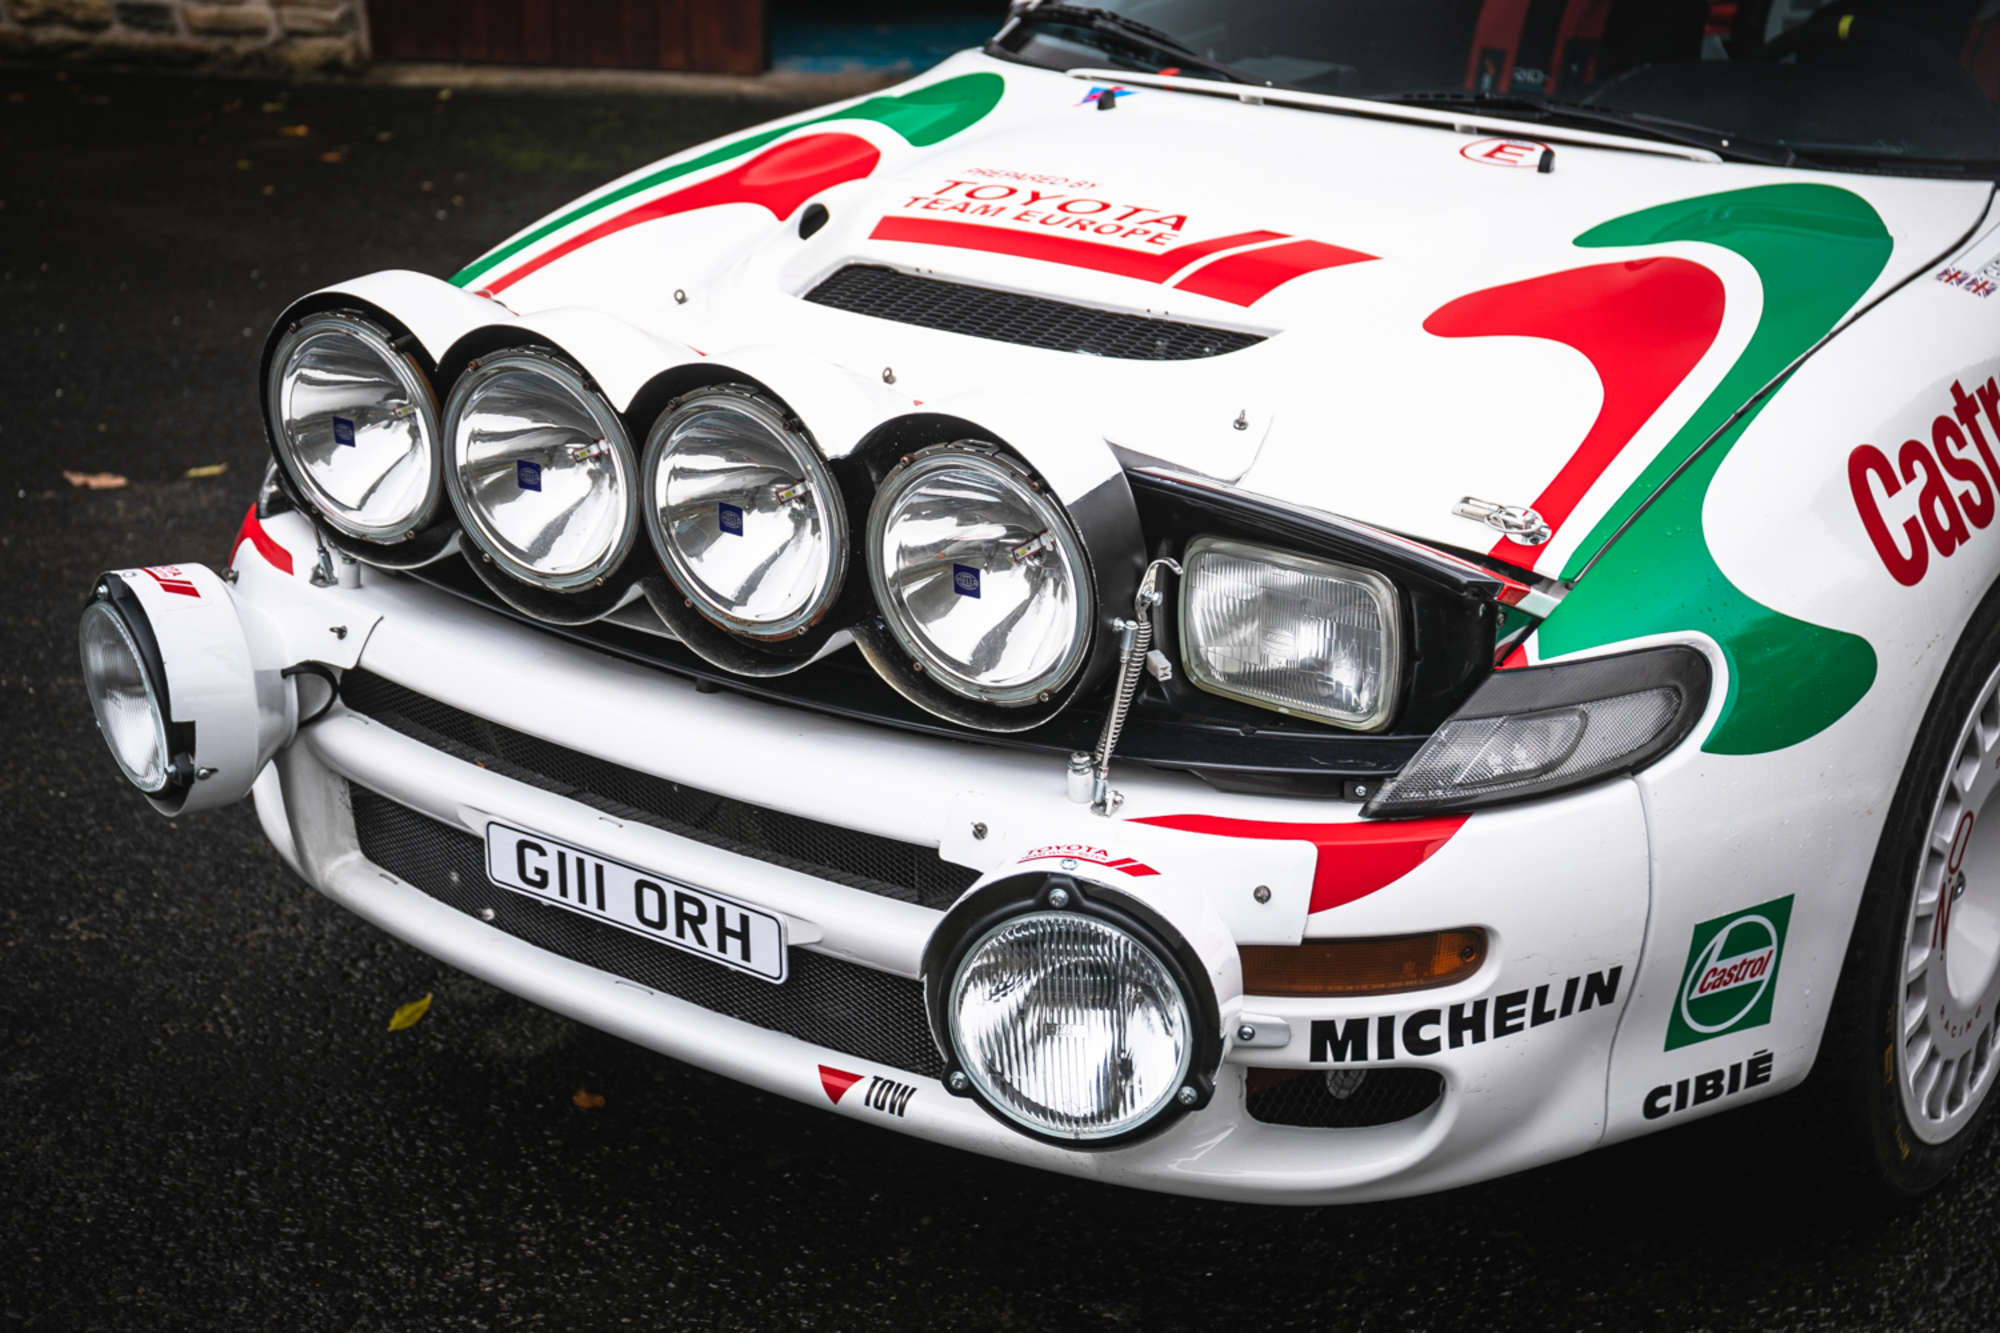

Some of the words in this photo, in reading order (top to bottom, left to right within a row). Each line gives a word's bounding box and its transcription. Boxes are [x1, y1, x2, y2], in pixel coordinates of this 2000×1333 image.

[962, 168, 1068, 187] PREPARED
[1482, 143, 1535, 165] E
[904, 196, 1008, 217] TEAM
[1012, 209, 1181, 246] EUROPE
[933, 180, 1188, 232] TOYOTA
[1027, 843, 1109, 857] TOYOTA
[634, 878, 752, 963] ORH
[1698, 948, 1775, 995] Castrol
[1309, 965, 1624, 1063] MICHELIN
[864, 1075, 917, 1118] TOW
[1642, 1048, 1774, 1120] CIBIÉ
